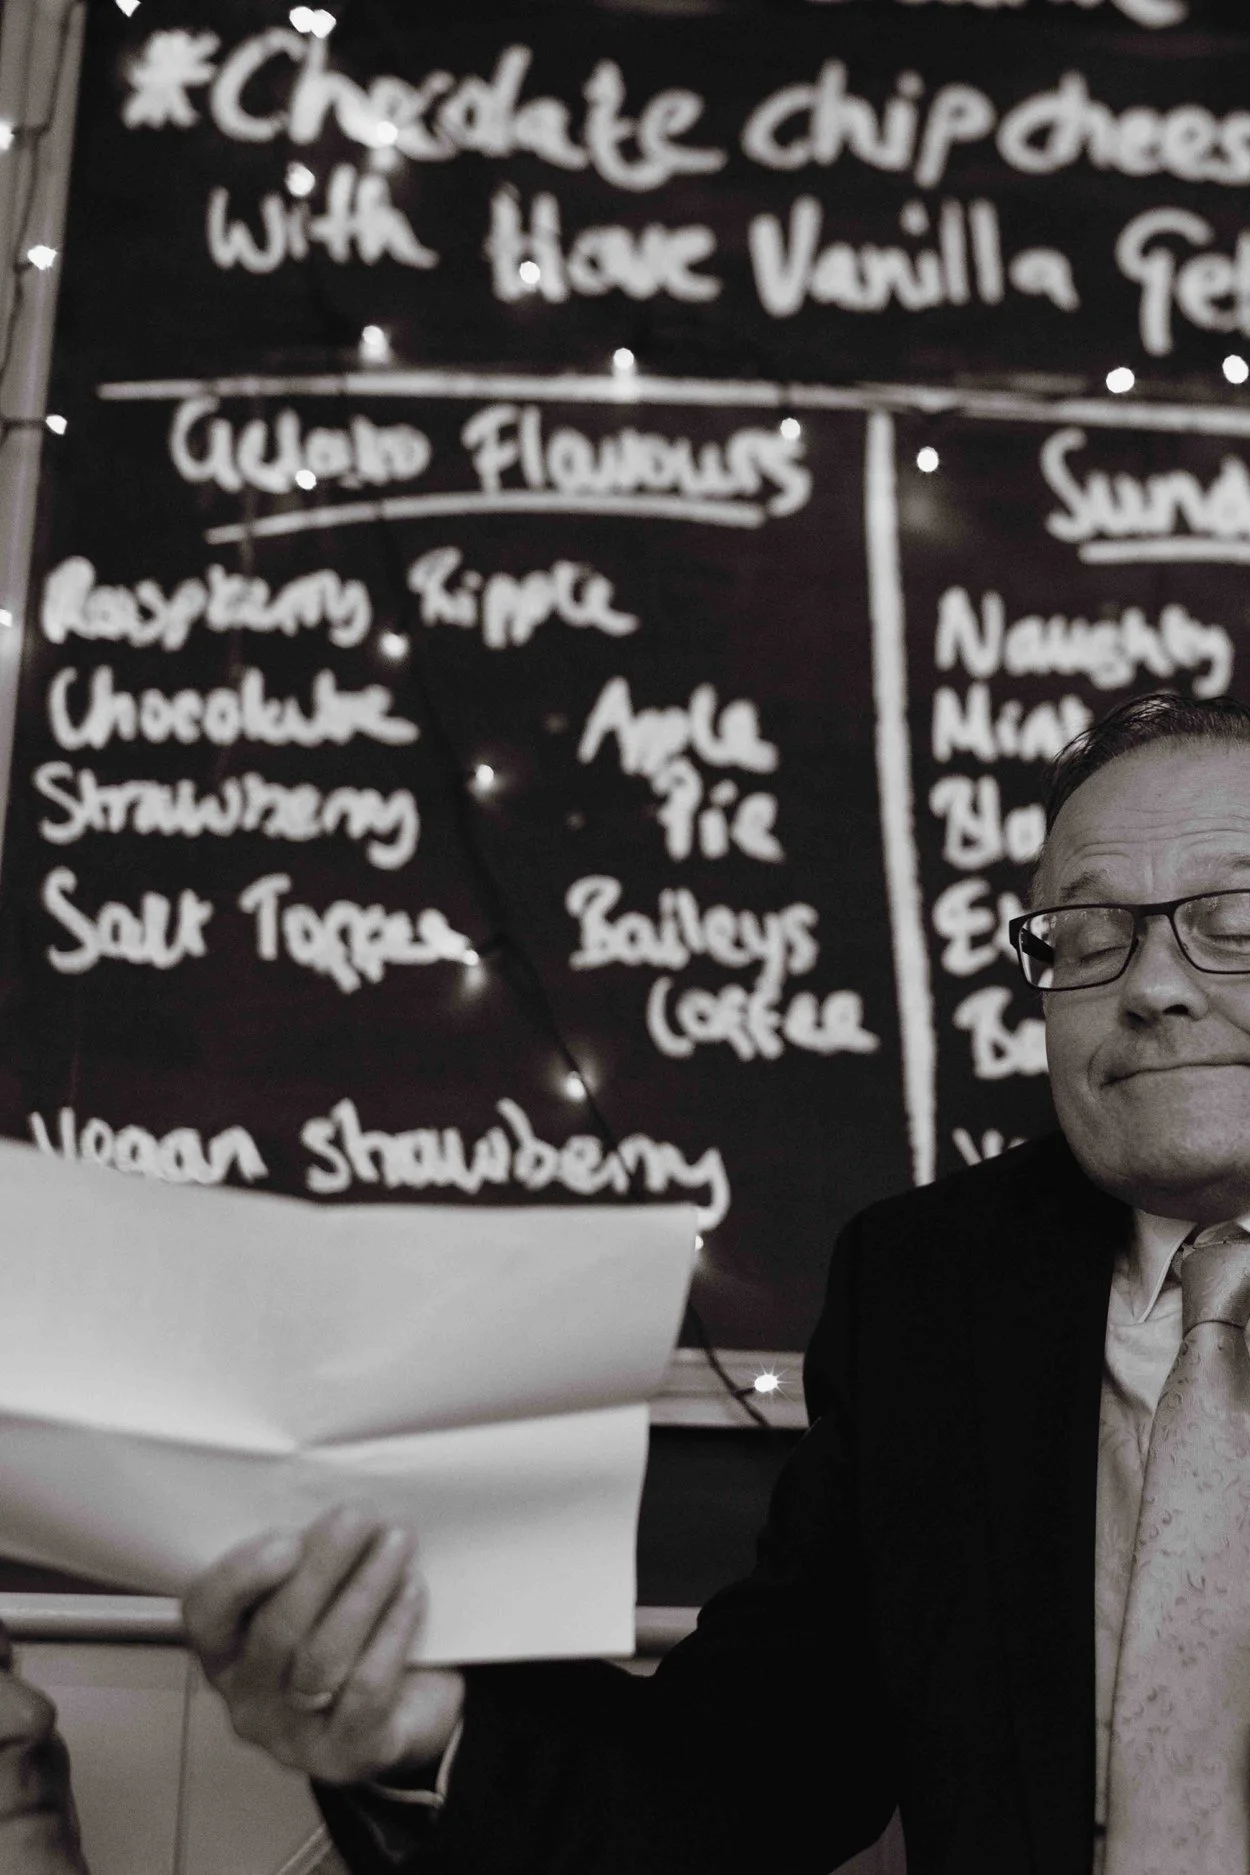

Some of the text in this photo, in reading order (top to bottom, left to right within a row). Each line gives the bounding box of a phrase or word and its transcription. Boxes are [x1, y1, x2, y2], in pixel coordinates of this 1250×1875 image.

[748, 197, 1080, 318] Vanilla
[406, 547, 640, 650] Ripple
[935, 585, 1236, 700] Naughty
[48, 664, 422, 752] Chocolate
[576, 675, 780, 775] Apple
[32, 760, 420, 870] Strawberry
[650, 754, 786, 862] Pie
[42, 865, 216, 976] Salt
[564, 874, 820, 1005] Baileys
[645, 975, 880, 1060] Coffee
